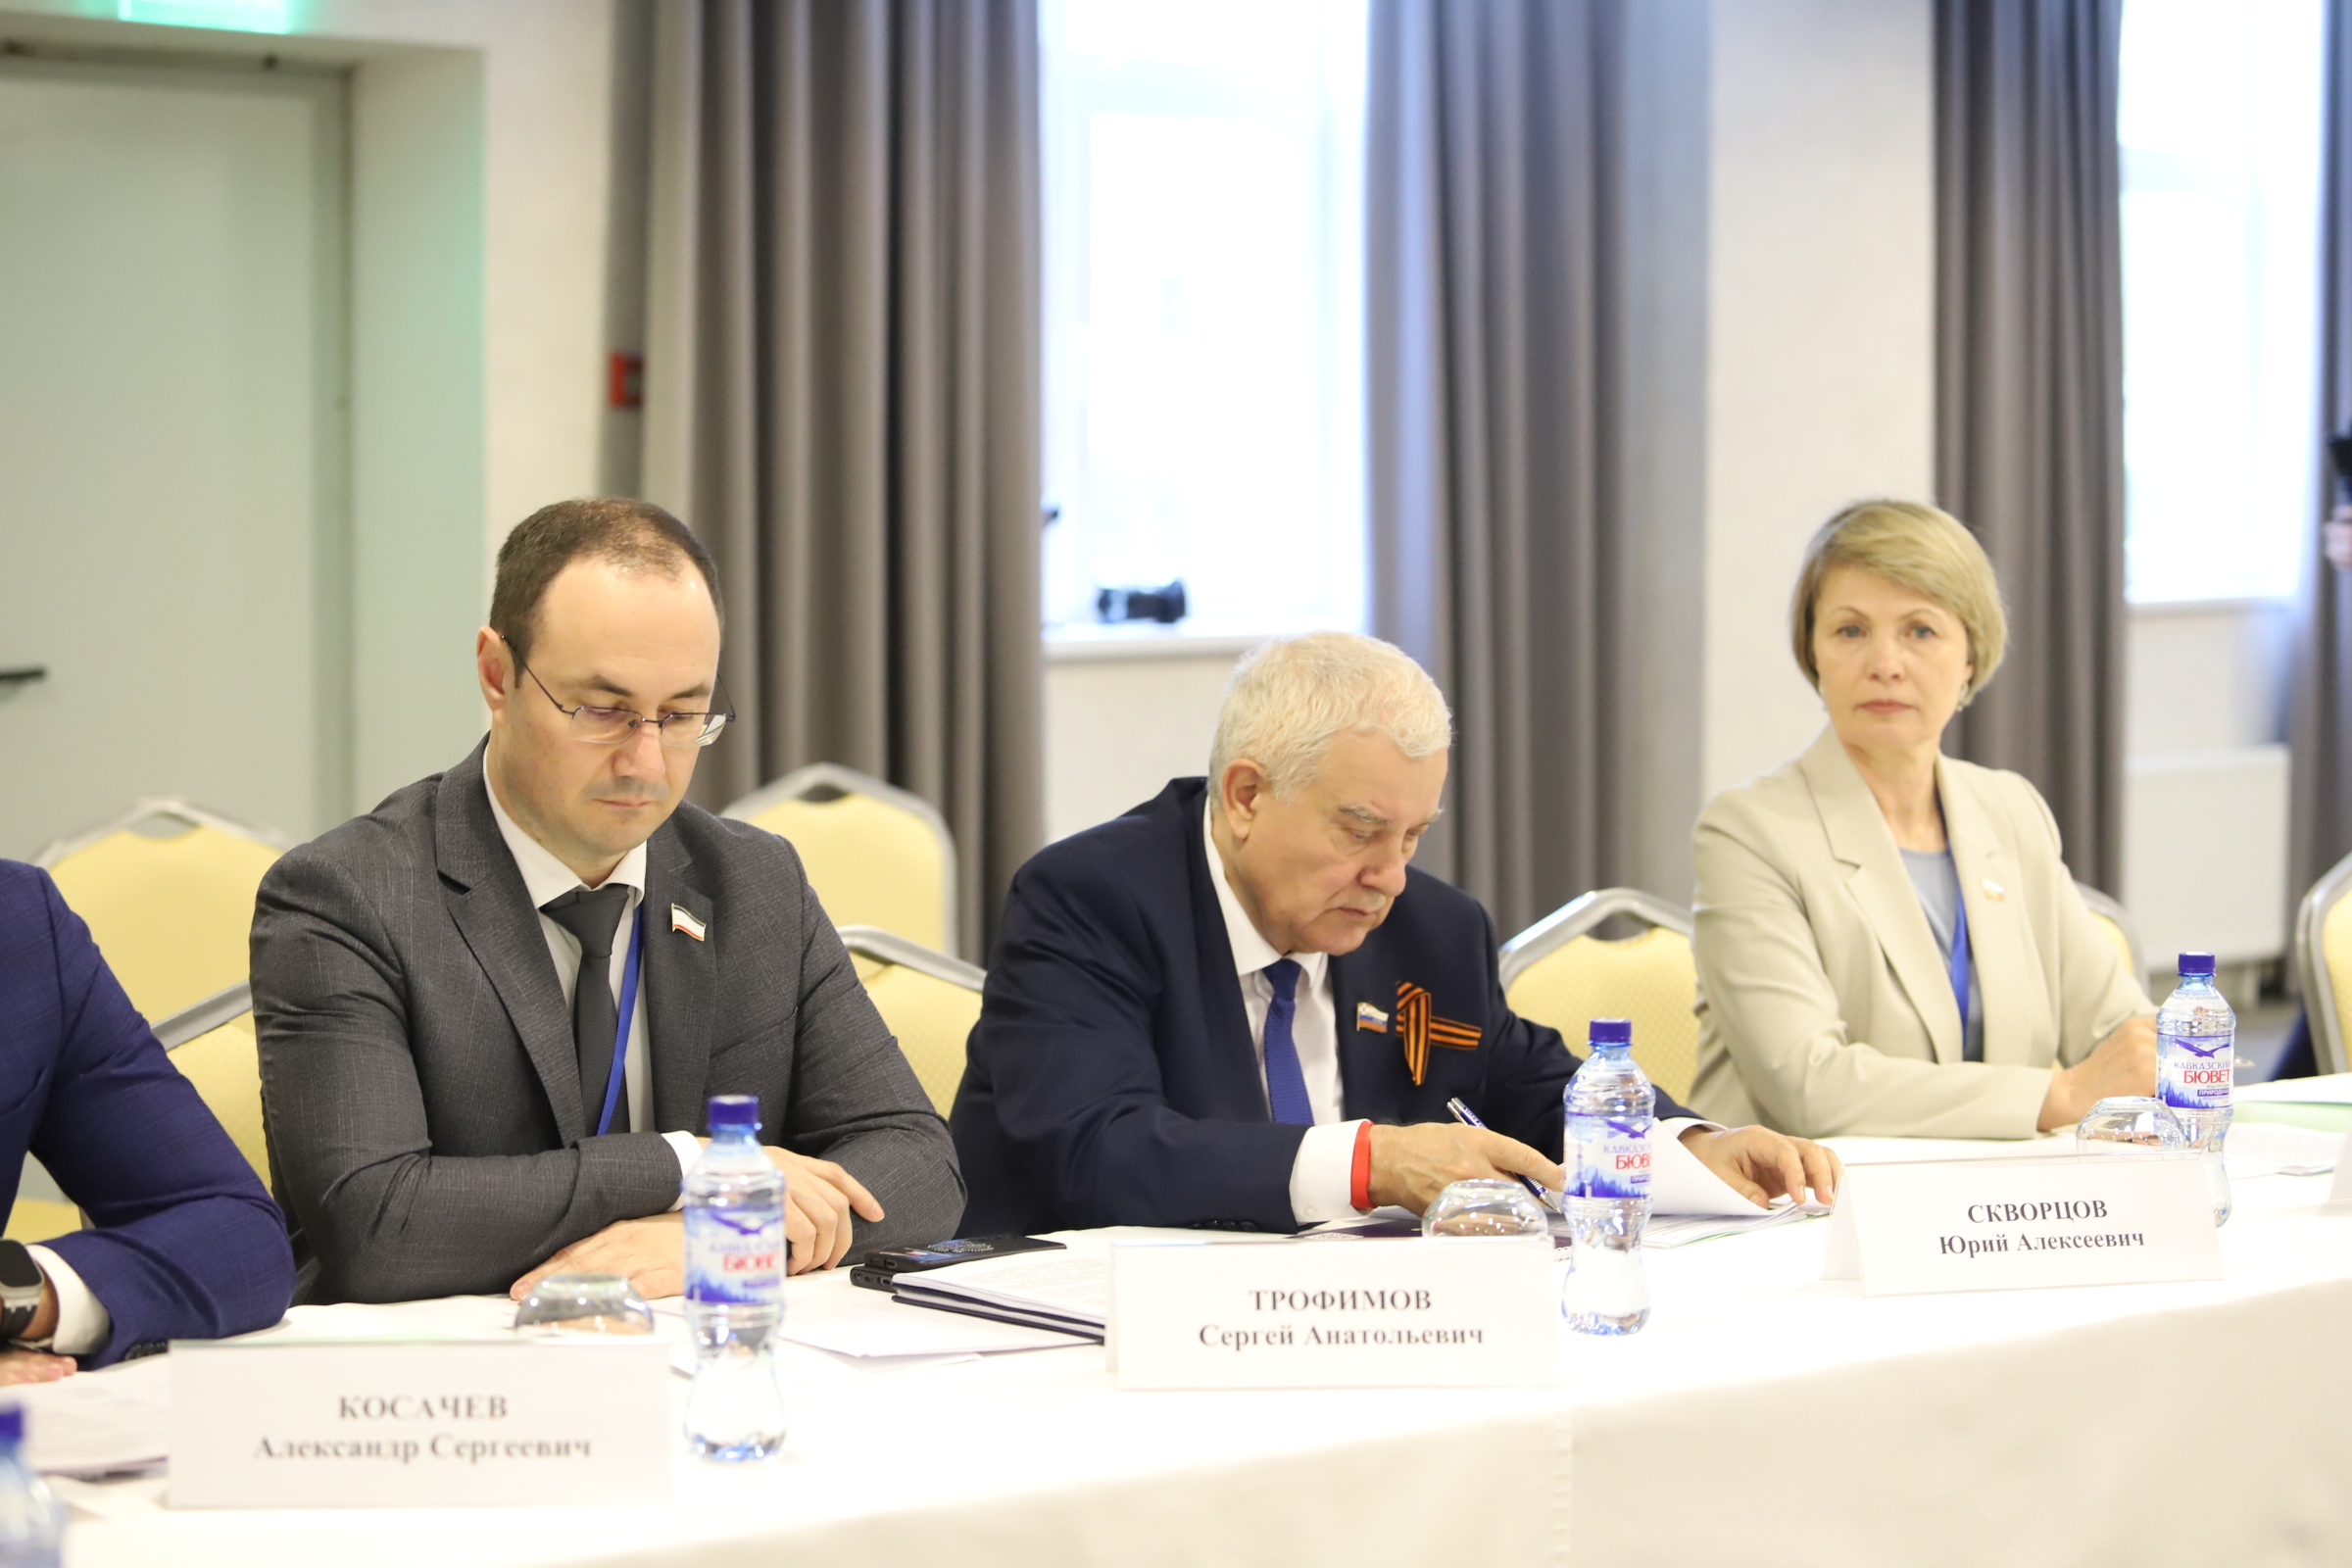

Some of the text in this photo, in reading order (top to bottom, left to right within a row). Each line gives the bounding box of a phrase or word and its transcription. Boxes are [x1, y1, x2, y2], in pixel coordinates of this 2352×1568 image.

[2174, 1060, 2231, 1070] КАВКАЗСКИЙ
[2183, 1069, 2230, 1084] БЮВЕТ
[1967, 1200, 2108, 1224] СКВОРЦОВ
[1939, 1231, 2145, 1259] Юрий Алексеевич
[1250, 1289, 1433, 1312] ТРОФИМОВ
[1199, 1323, 1484, 1352] Сергей Анатольевич
[338, 1396, 510, 1420] КОСАЧЕВ
[254, 1434, 592, 1464] Александр Сергеевич
